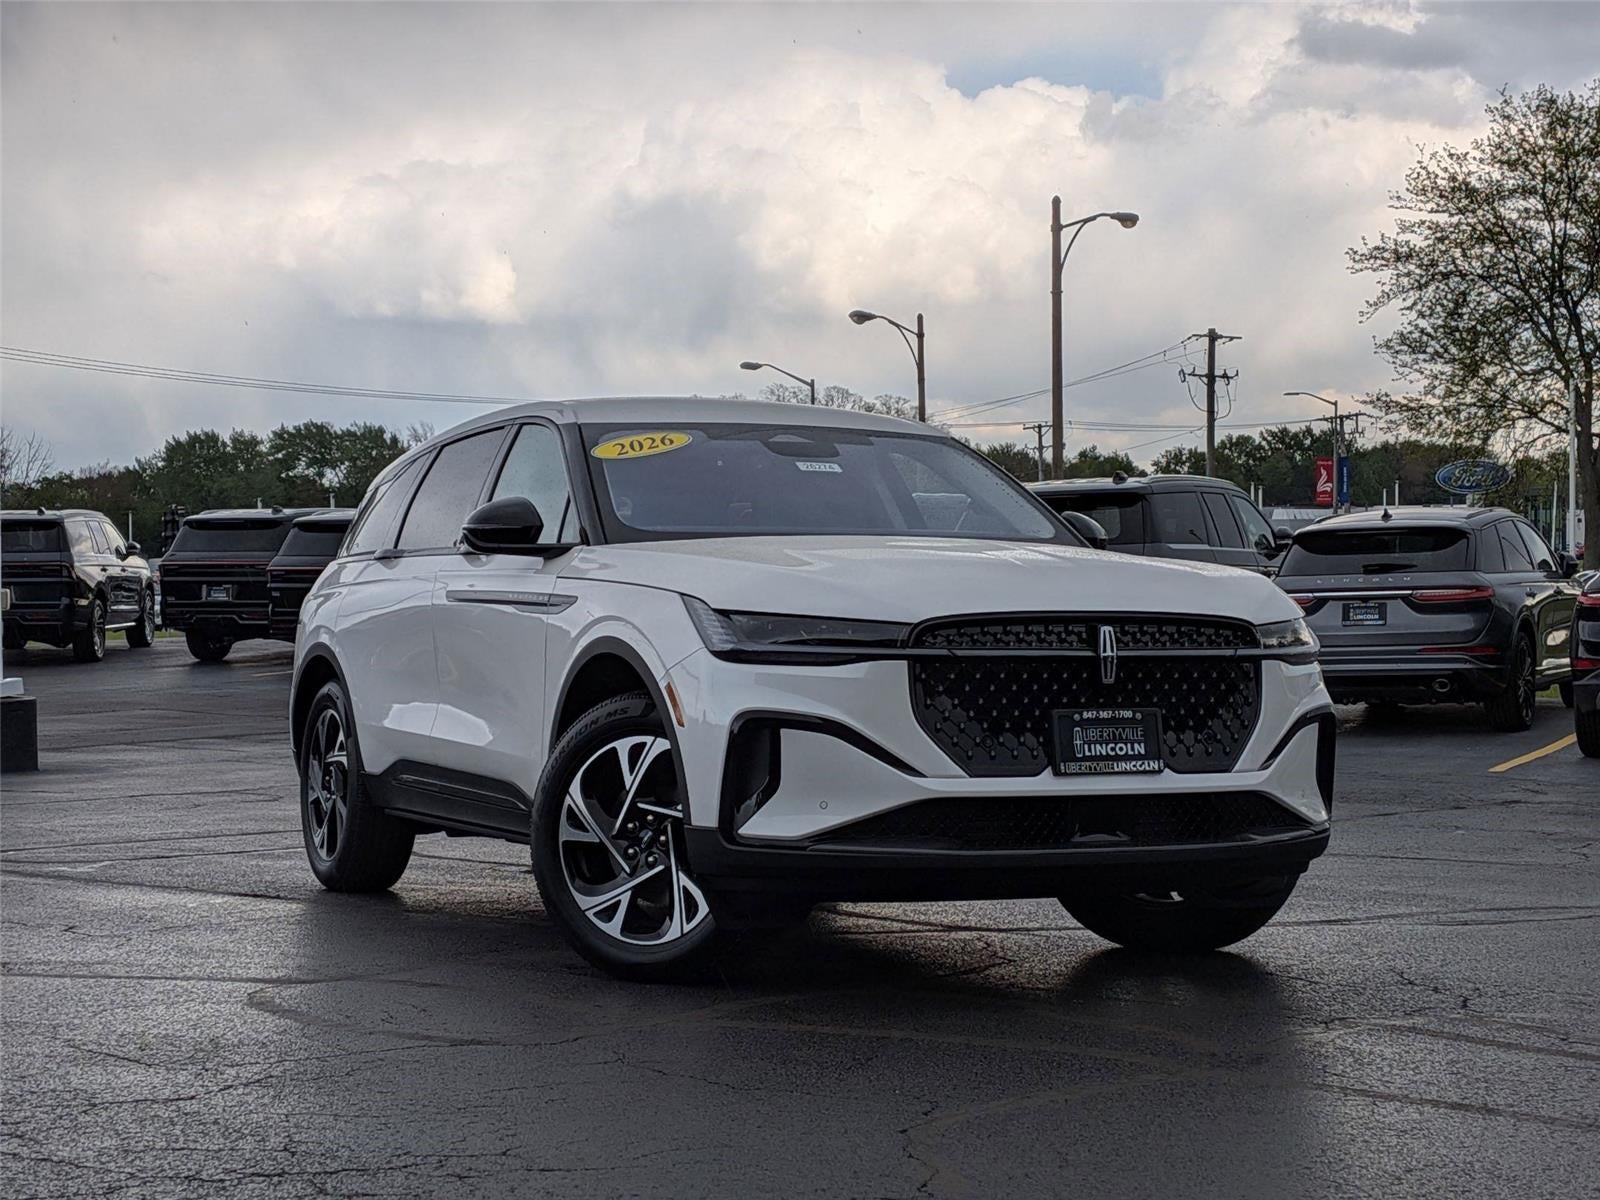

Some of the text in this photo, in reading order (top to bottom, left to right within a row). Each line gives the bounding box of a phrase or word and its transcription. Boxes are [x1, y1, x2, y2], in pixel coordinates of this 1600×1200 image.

[612, 433, 675, 456] 2026
[1451, 467, 1495, 487] Ford
[1082, 710, 1133, 719] 847-367-1700
[1084, 742, 1146, 756] LINCOLN
